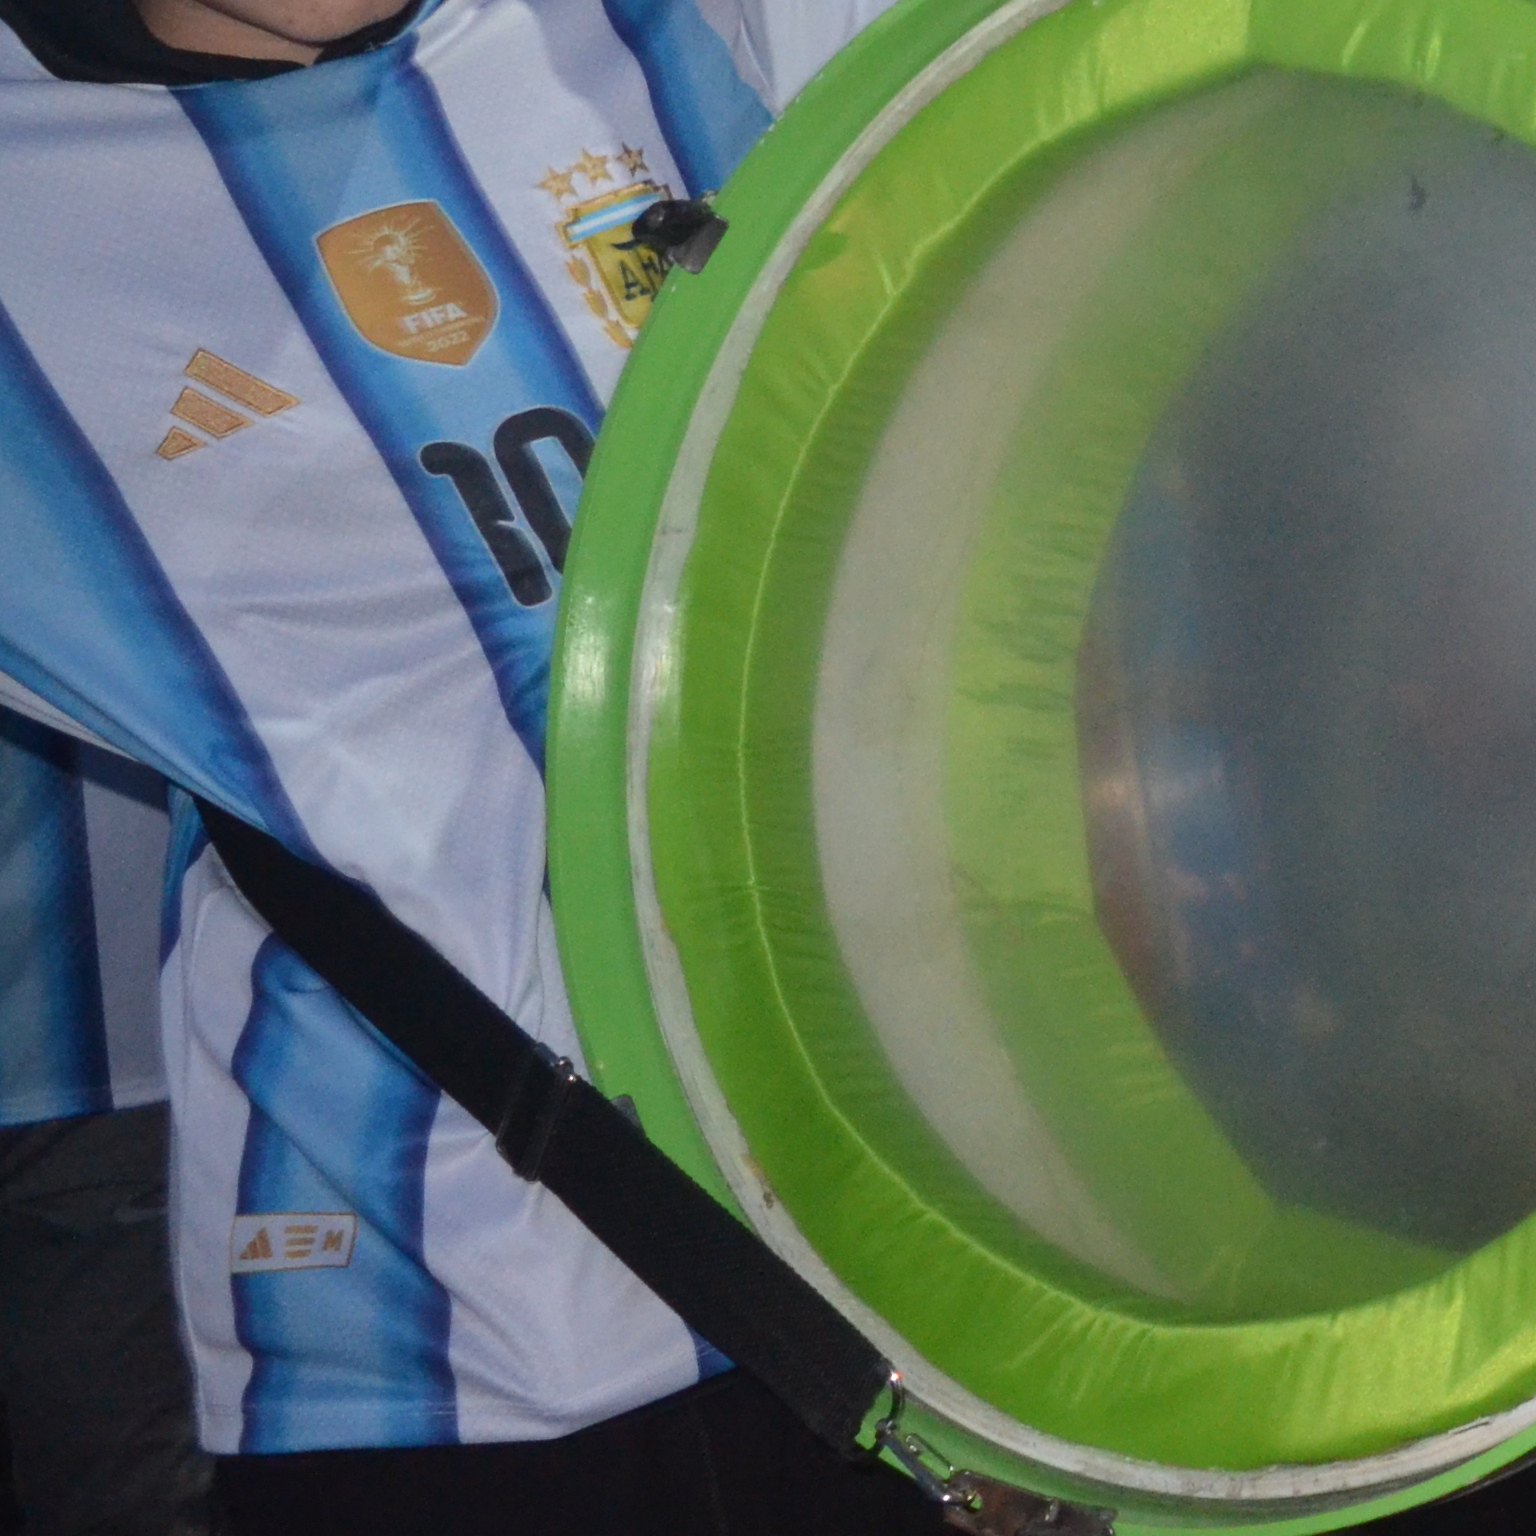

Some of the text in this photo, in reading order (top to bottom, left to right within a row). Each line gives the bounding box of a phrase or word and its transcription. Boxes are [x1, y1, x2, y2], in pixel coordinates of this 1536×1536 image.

[403, 302, 468, 335] FIFA
[425, 330, 470, 353] 2022
[417, 405, 596, 607] 10
